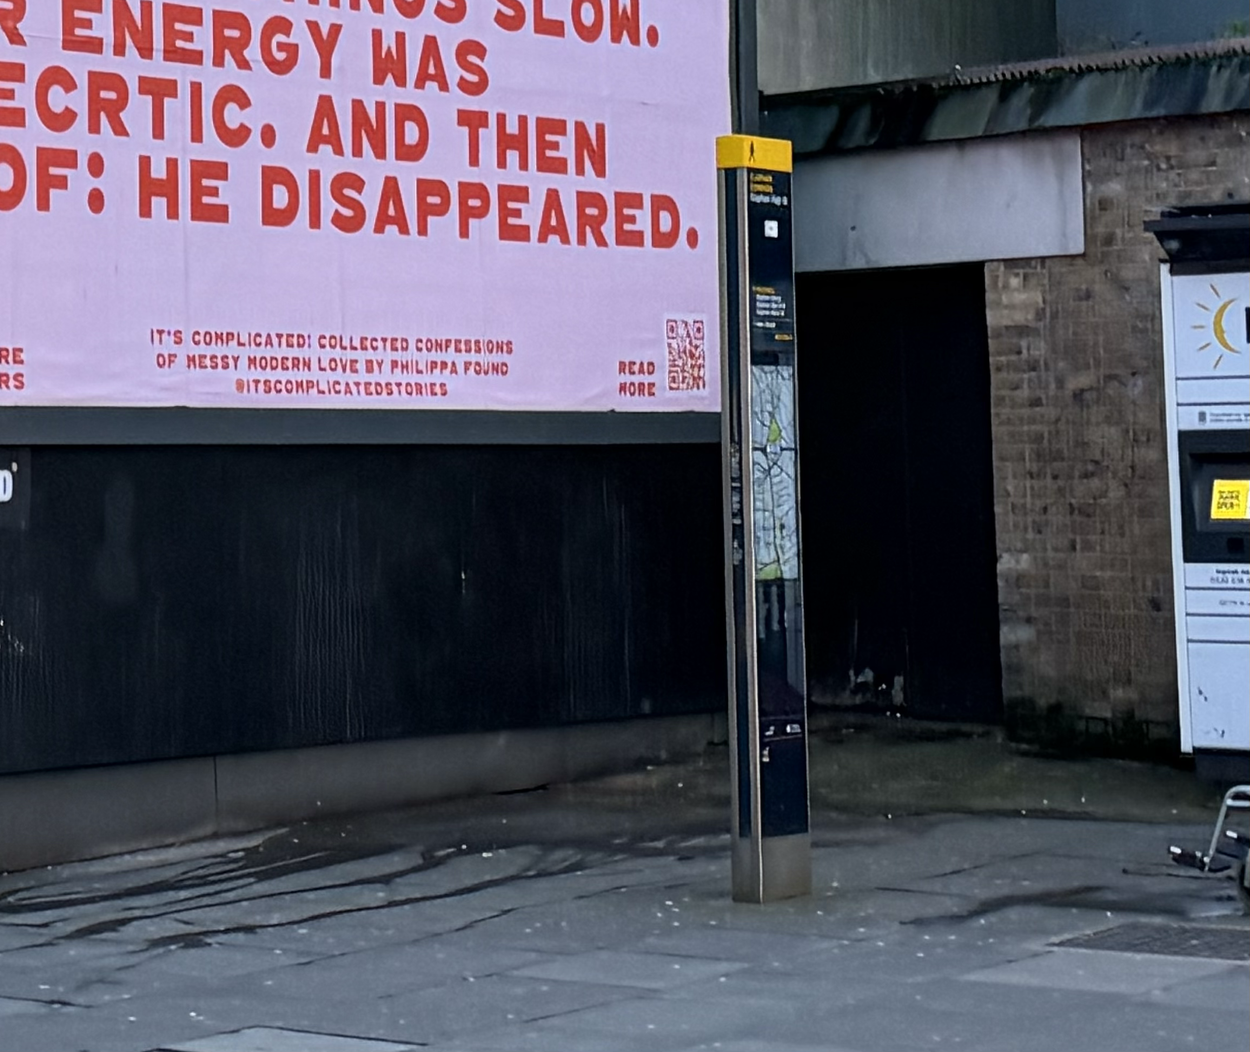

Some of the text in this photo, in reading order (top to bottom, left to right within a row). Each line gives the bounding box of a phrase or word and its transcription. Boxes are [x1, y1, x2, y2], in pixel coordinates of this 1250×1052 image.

[371, 27, 490, 97] WAS
[305, 93, 430, 163] AND
[456, 108, 607, 179] THEN
[138, 154, 230, 224] HE
[260, 164, 699, 249] DISAPPEARED.
[150, 328, 184, 346] IT'S
[317, 334, 410, 353] COLLECTED
[414, 337, 514, 355] CONFESSIONS
[155, 353, 509, 377] OF MESSY MODERN LOVE BY PHILIPPA FOUND
[617, 359, 656, 376] READ
[235, 378, 448, 397] @ITSCOMPLICATEDSTORIES
[618, 381, 656, 397] MORE
